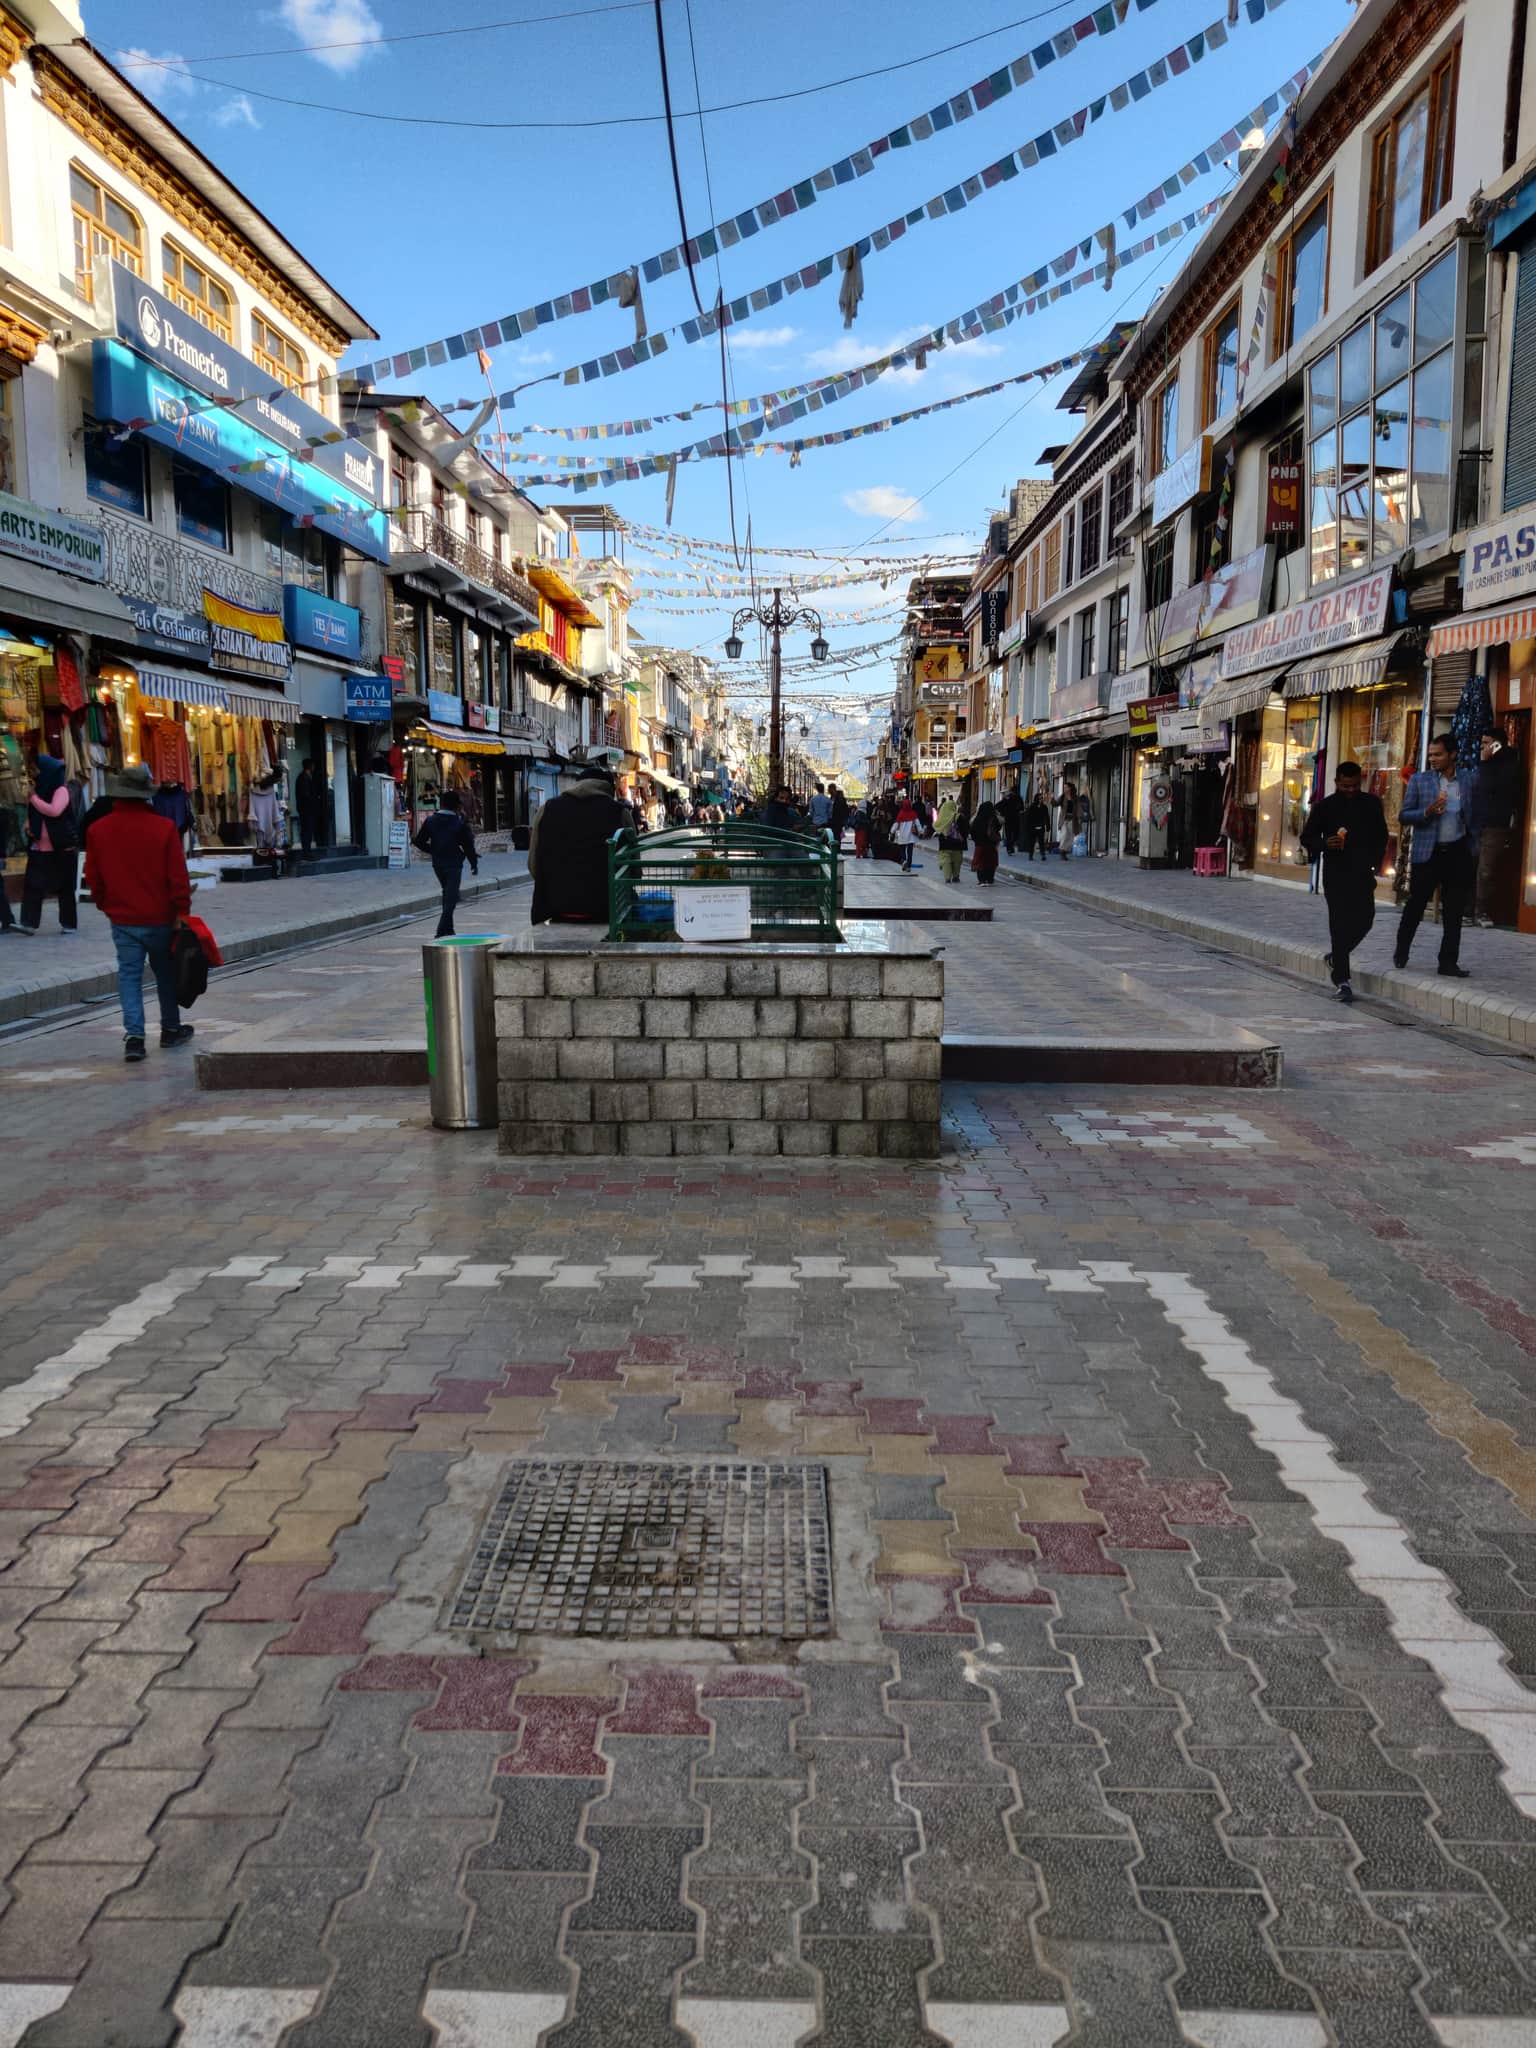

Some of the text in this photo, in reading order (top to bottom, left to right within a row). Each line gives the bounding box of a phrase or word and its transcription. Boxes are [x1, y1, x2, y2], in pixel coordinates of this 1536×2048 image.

[163, 318, 229, 390] Pramerica
[158, 397, 216, 447] YES BANK
[257, 397, 301, 440] LIFE INSURANCE
[1271, 466, 1298, 479] PNB
[1, 511, 36, 540] ARTS
[39, 523, 102, 563] EMPORIUM
[1272, 521, 1293, 531] LEH
[1308, 576, 1384, 632] CRAFTS
[213, 624, 245, 655] ASIAN
[244, 634, 288, 667] EMPORIUM
[314, 617, 346, 638] YES BANK
[353, 685, 385, 698] ATM
